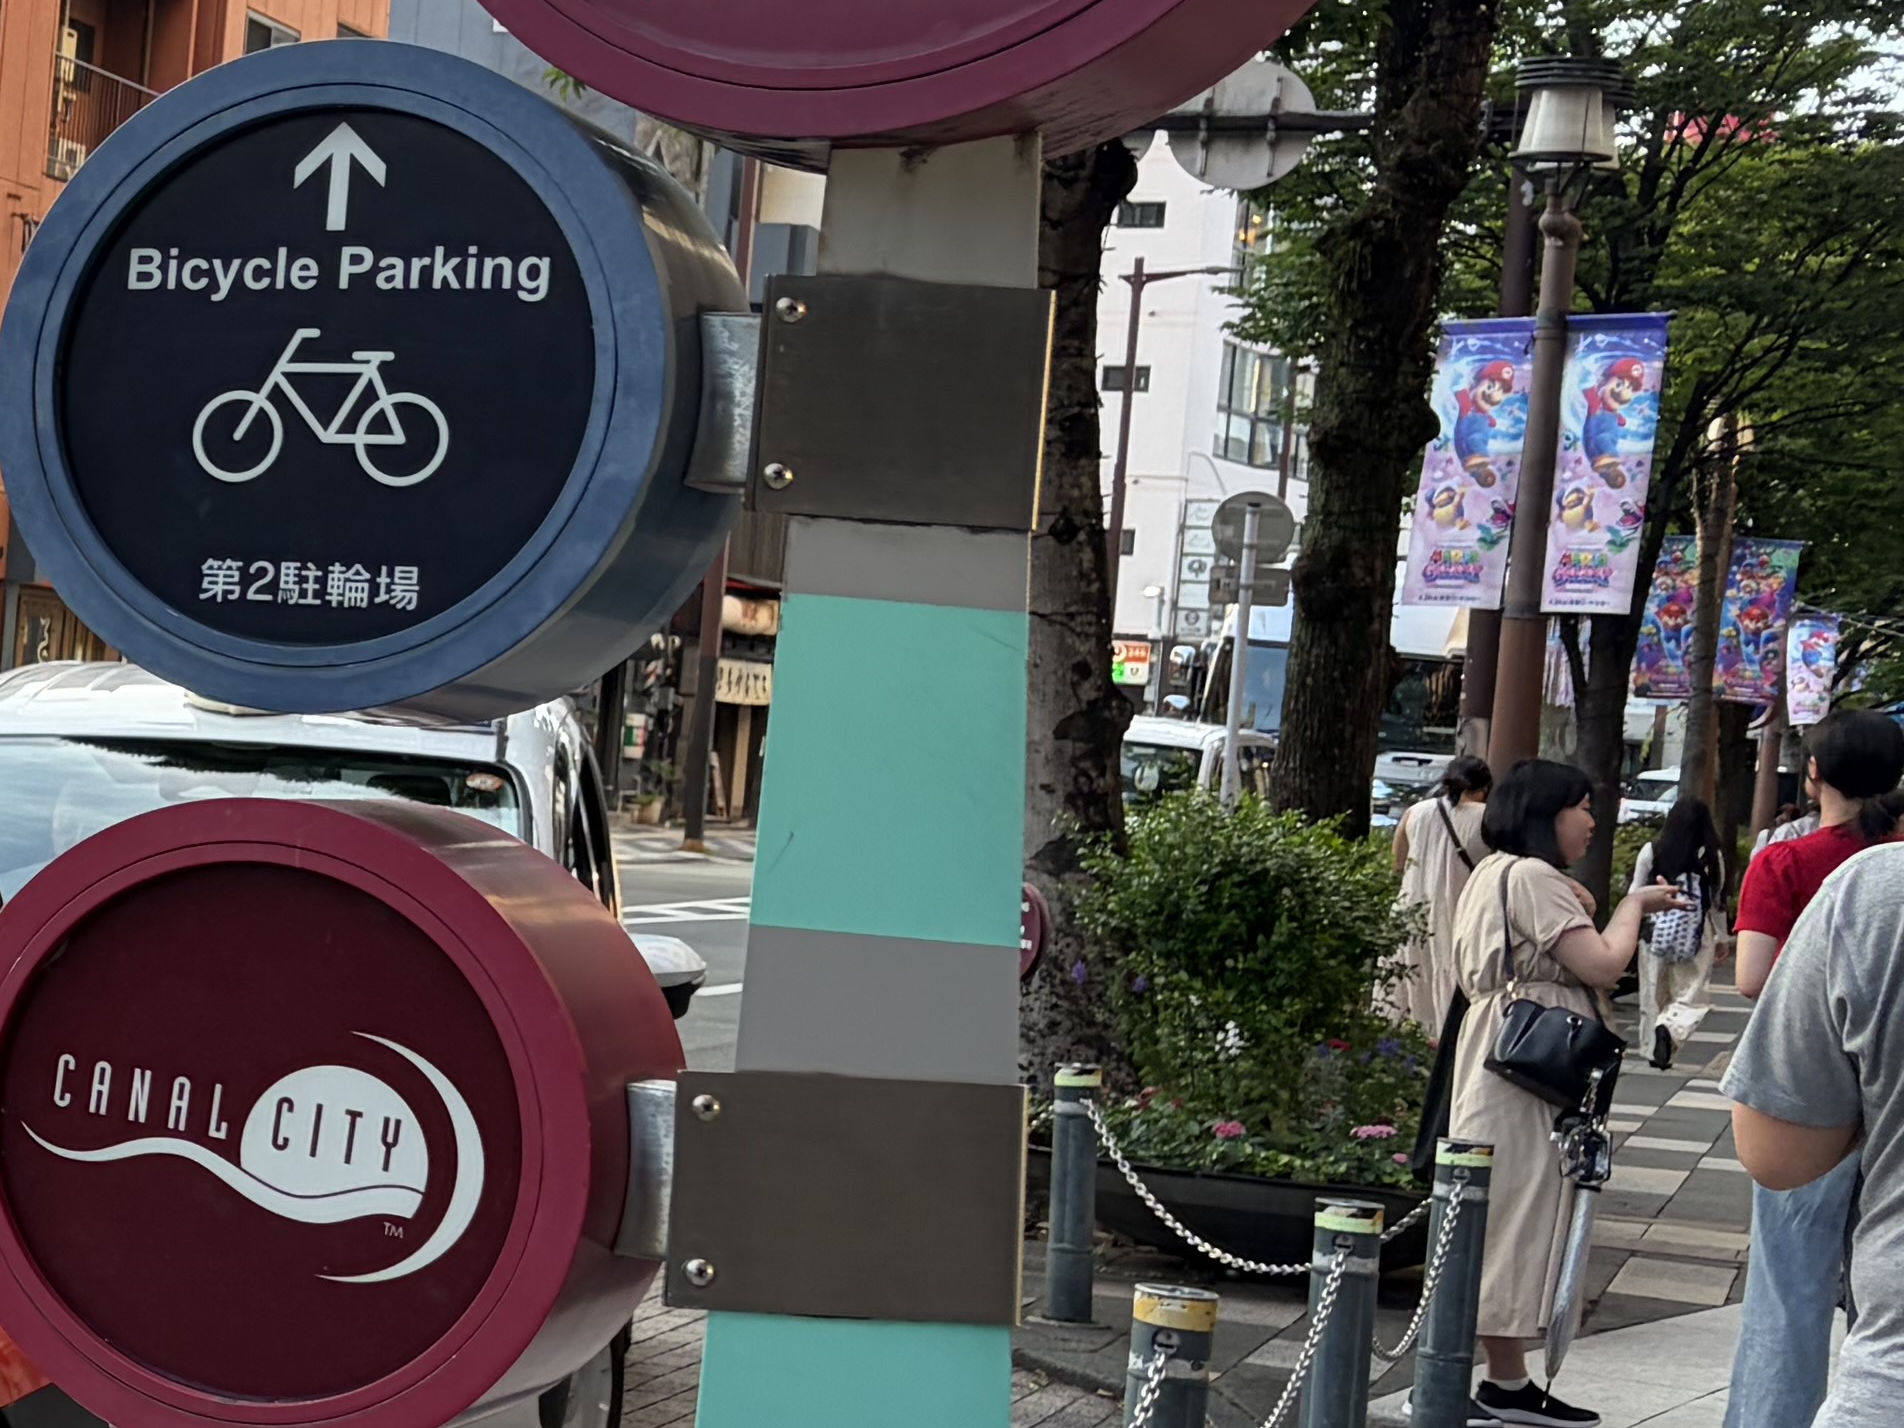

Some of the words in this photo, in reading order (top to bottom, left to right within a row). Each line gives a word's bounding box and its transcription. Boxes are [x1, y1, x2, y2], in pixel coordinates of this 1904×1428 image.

[127, 245, 320, 302] Bicycle
[338, 245, 552, 302] Parking
[198, 556, 421, 612] 第2駐輪場
[53, 1053, 229, 1141] CANAL
[270, 1095, 405, 1173] CITY
[382, 1221, 405, 1239] TM
